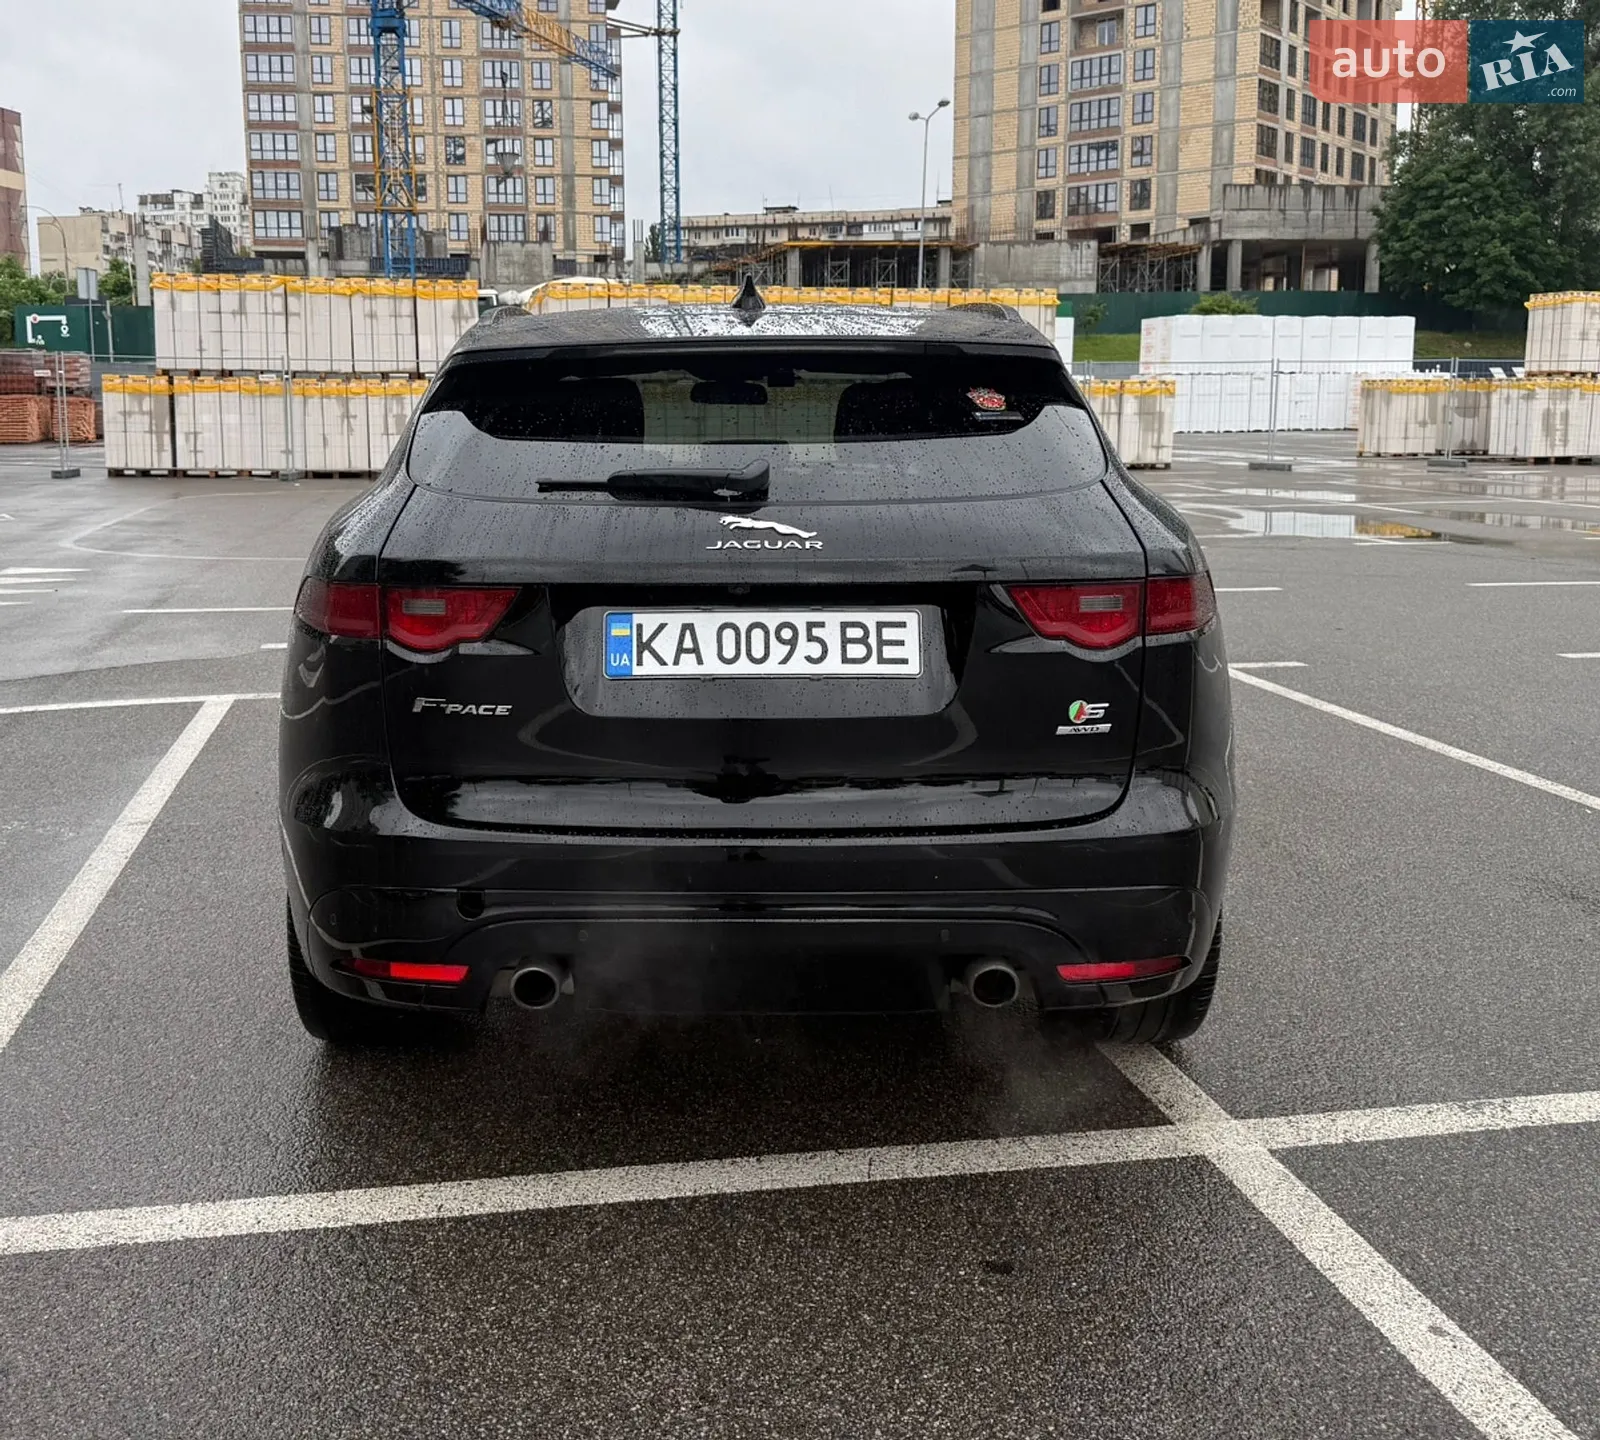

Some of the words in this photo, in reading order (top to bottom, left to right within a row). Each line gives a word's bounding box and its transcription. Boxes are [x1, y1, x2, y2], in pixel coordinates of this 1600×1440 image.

[705, 540, 823, 550] JAGUAR
[636, 622, 704, 666] KA
[716, 621, 829, 665] 0095
[840, 621, 909, 665] BE
[610, 652, 630, 667] UA
